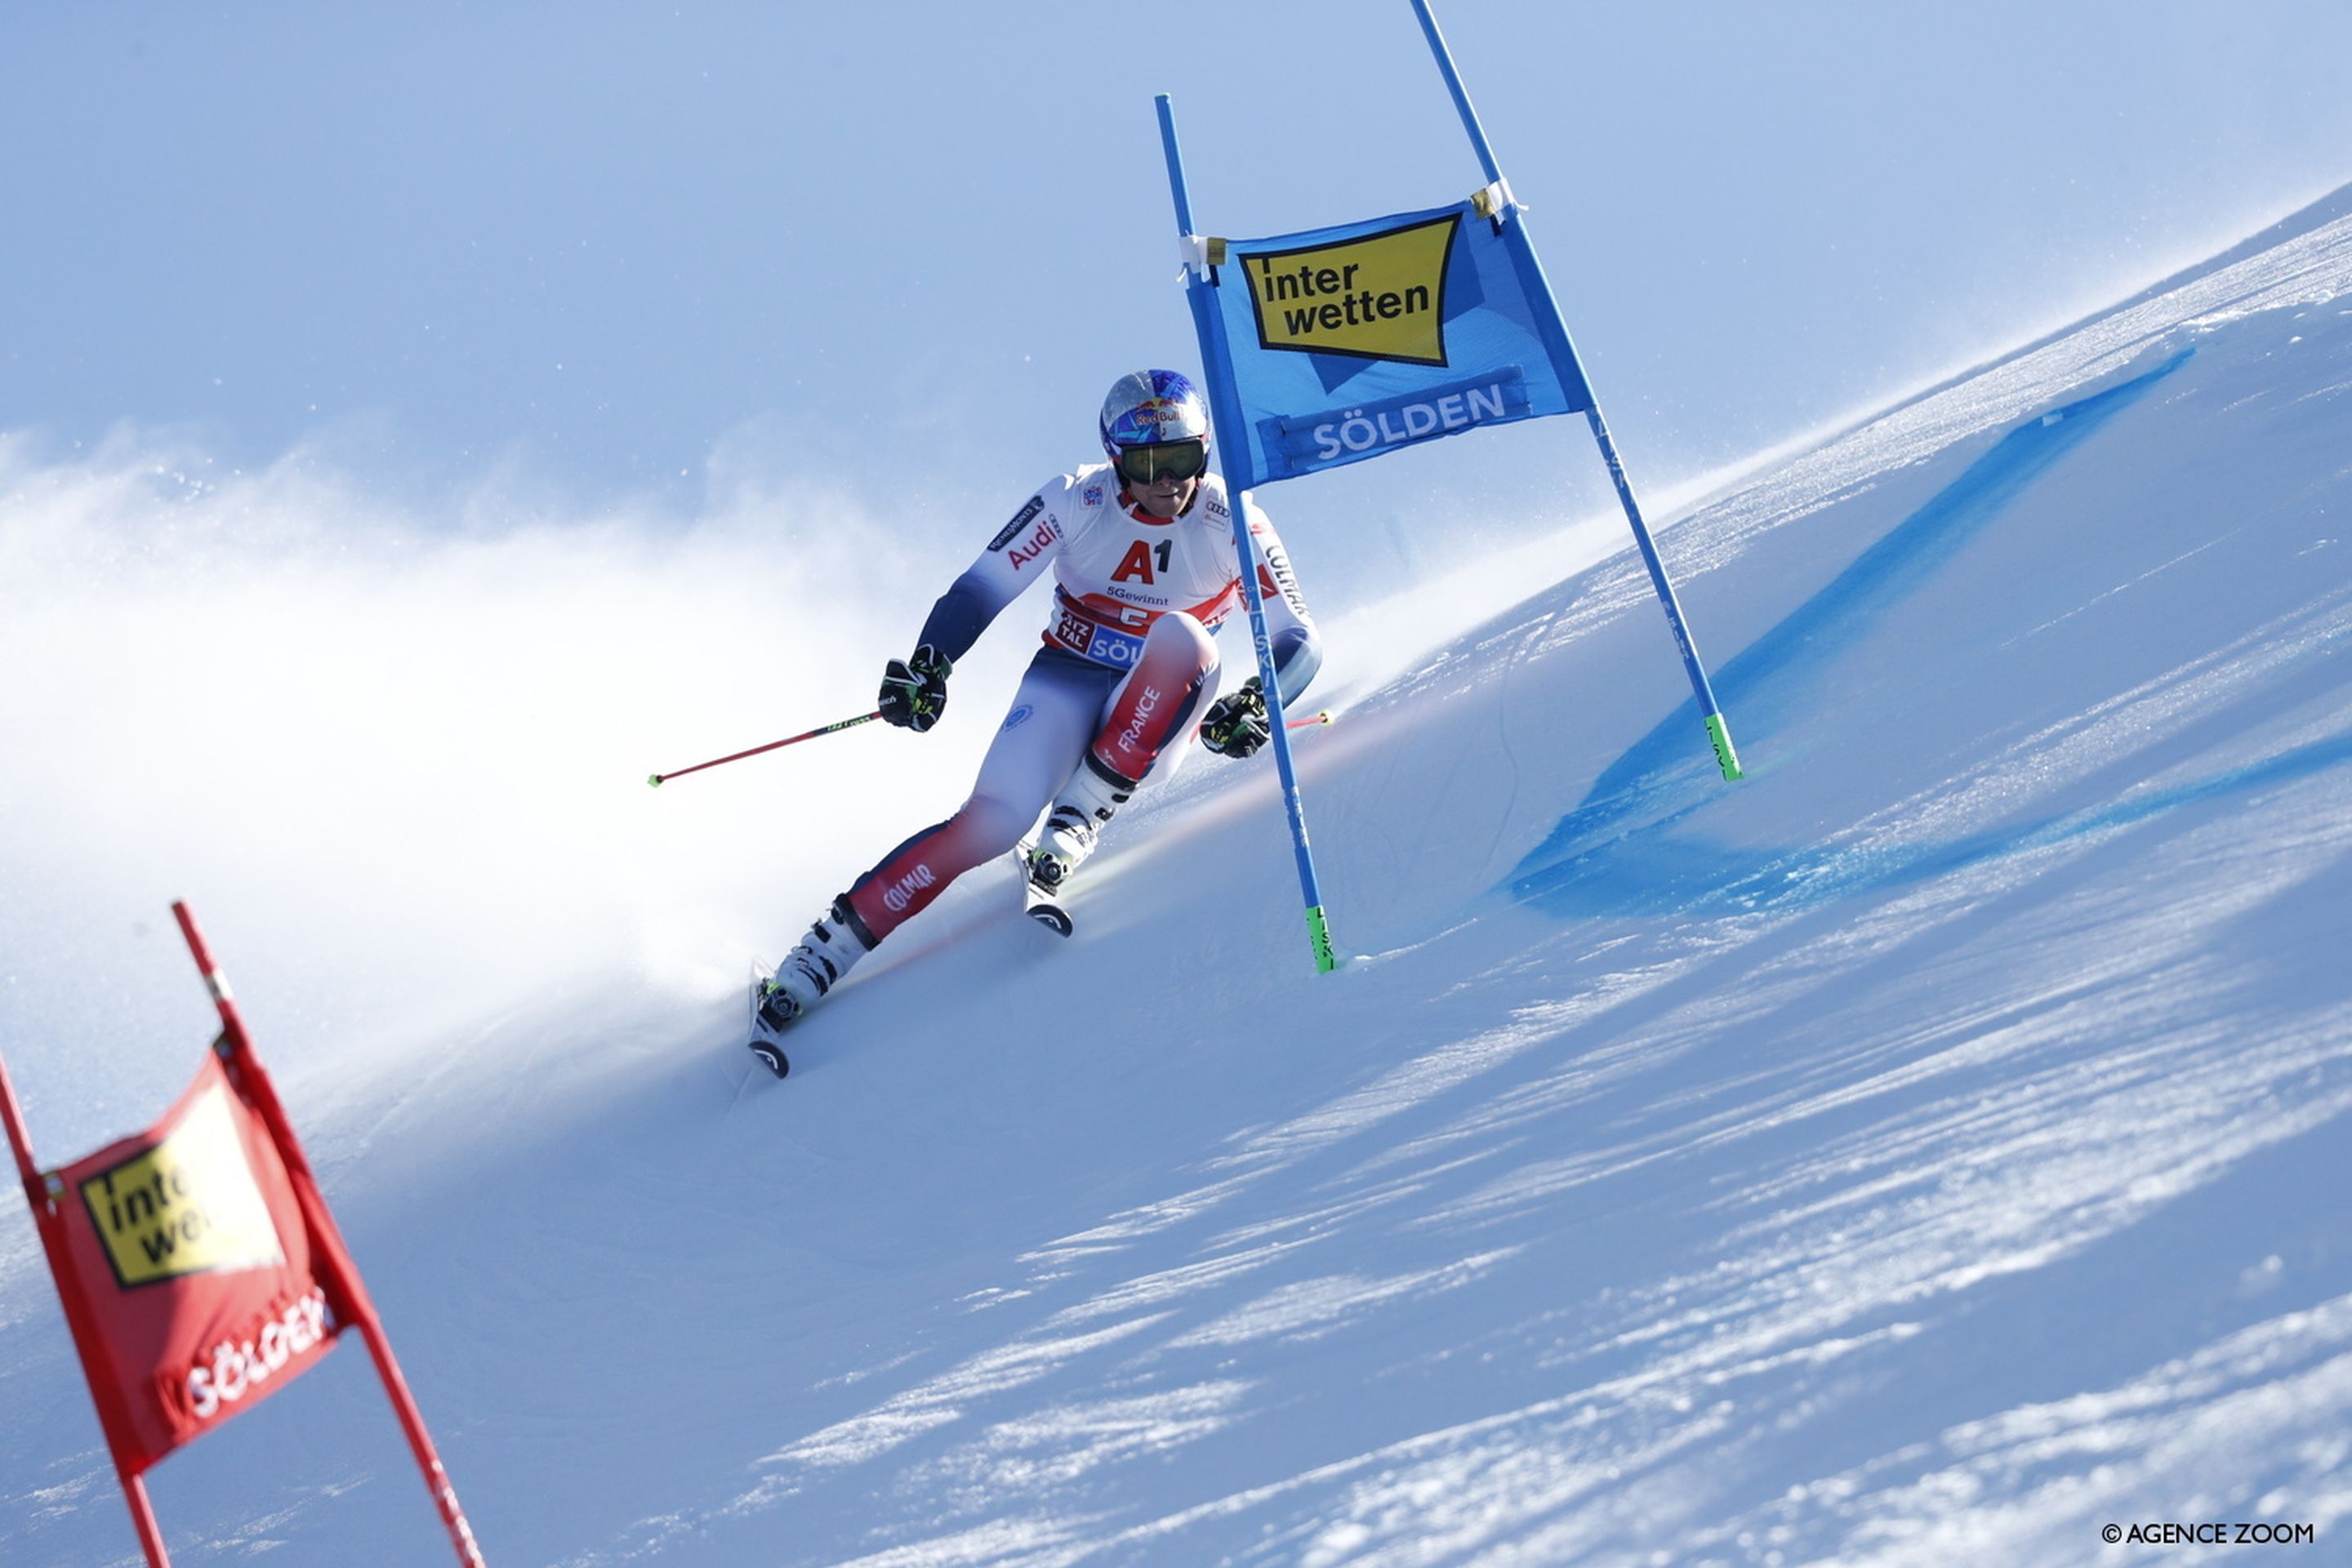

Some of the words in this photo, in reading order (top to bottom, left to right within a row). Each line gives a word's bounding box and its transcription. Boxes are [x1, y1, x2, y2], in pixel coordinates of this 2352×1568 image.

[1262, 258, 1359, 302] inter
[1284, 284, 1429, 336] wetten
[1313, 383, 1504, 461] SÖLDEN
[1008, 519, 1057, 571] Audi
[1109, 539, 1173, 586] A1
[1062, 624, 1084, 647] TAL
[1093, 639, 1143, 666] SÖL
[1117, 685, 1161, 753] FRANCE
[883, 863, 937, 912] COLMAR
[103, 1166, 189, 1234] inte
[186, 1285, 326, 1419] SÖLDEN
